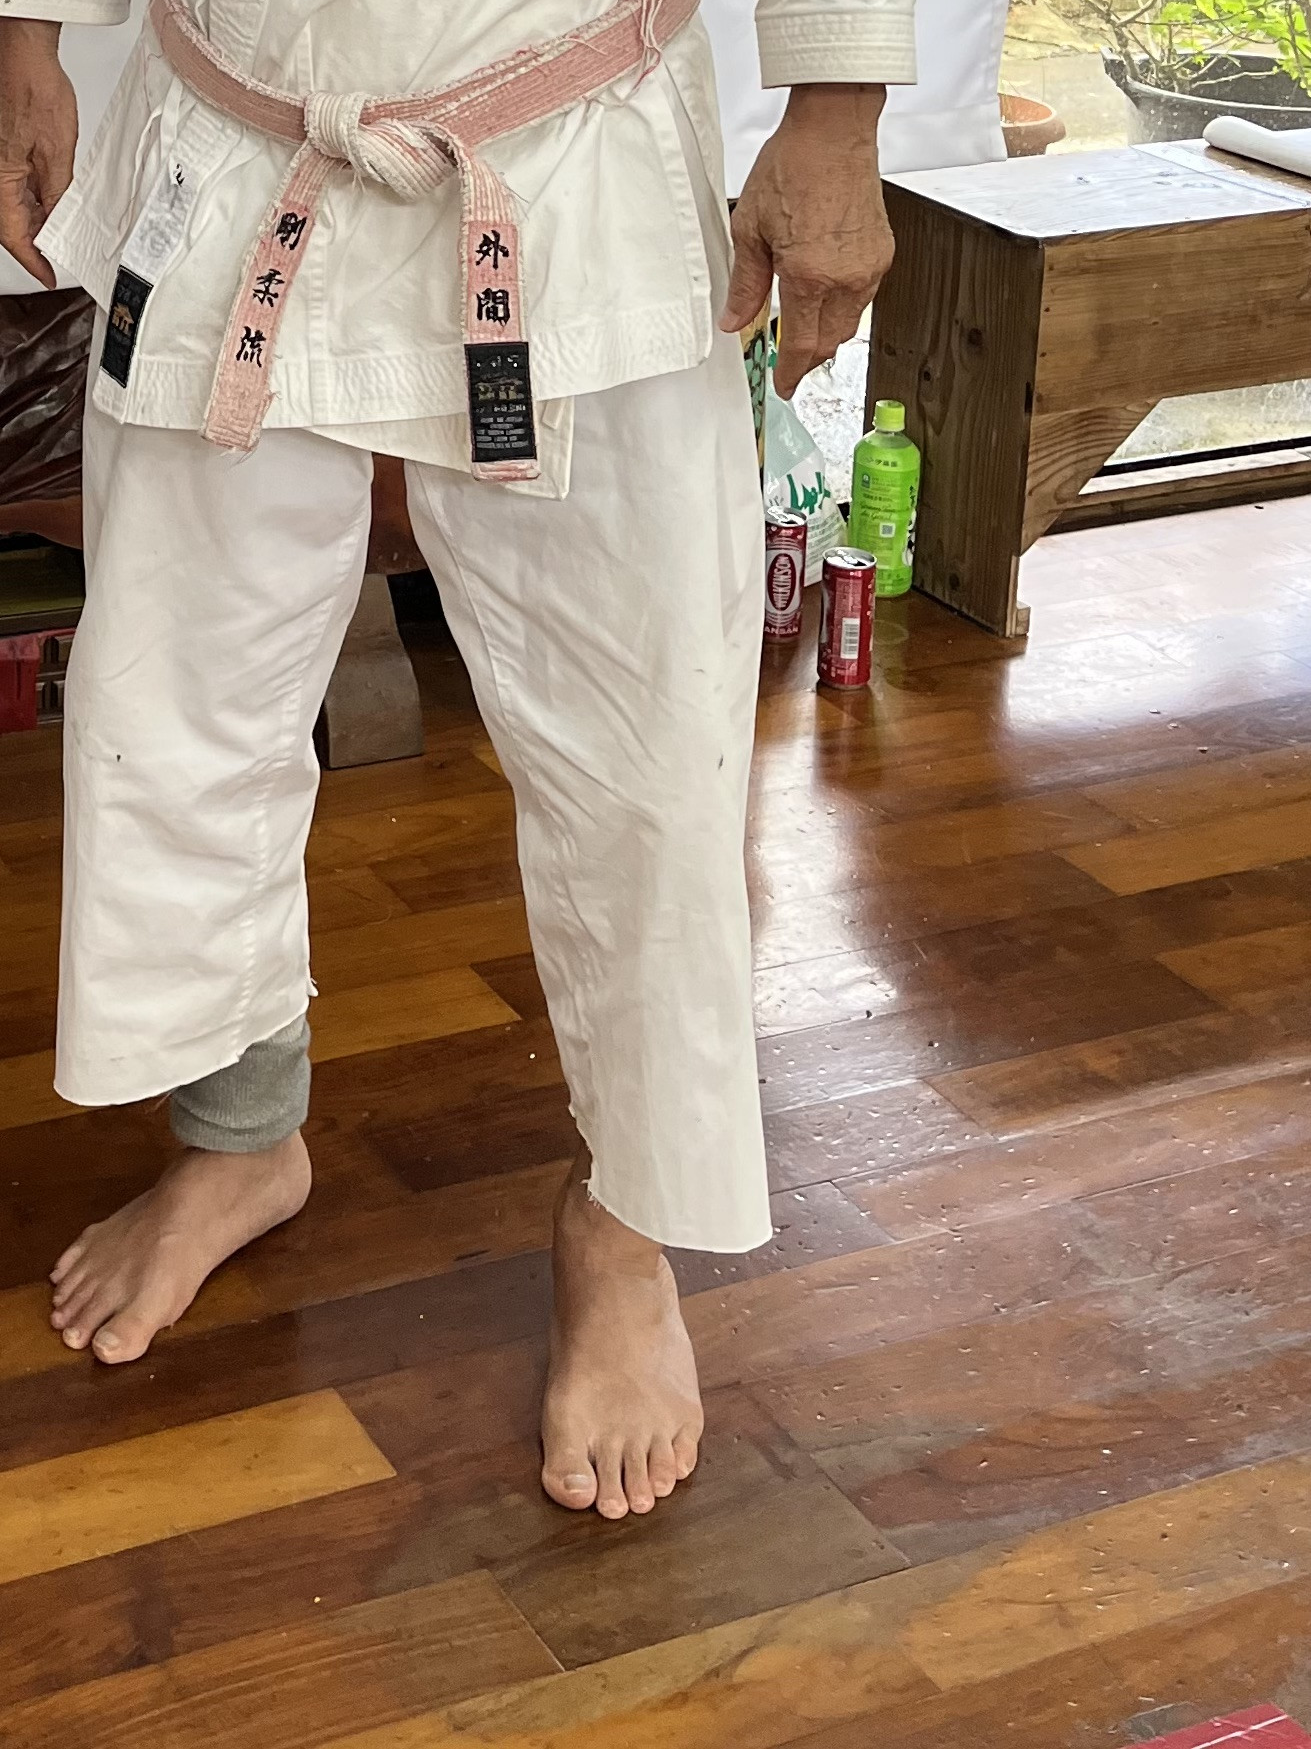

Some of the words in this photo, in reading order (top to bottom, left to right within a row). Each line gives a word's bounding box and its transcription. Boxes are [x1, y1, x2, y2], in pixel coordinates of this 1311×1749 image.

[236, 211, 307, 369] 剛柔流
[475, 229, 510, 327] 外間
[772, 555, 792, 609] WILKINSON
